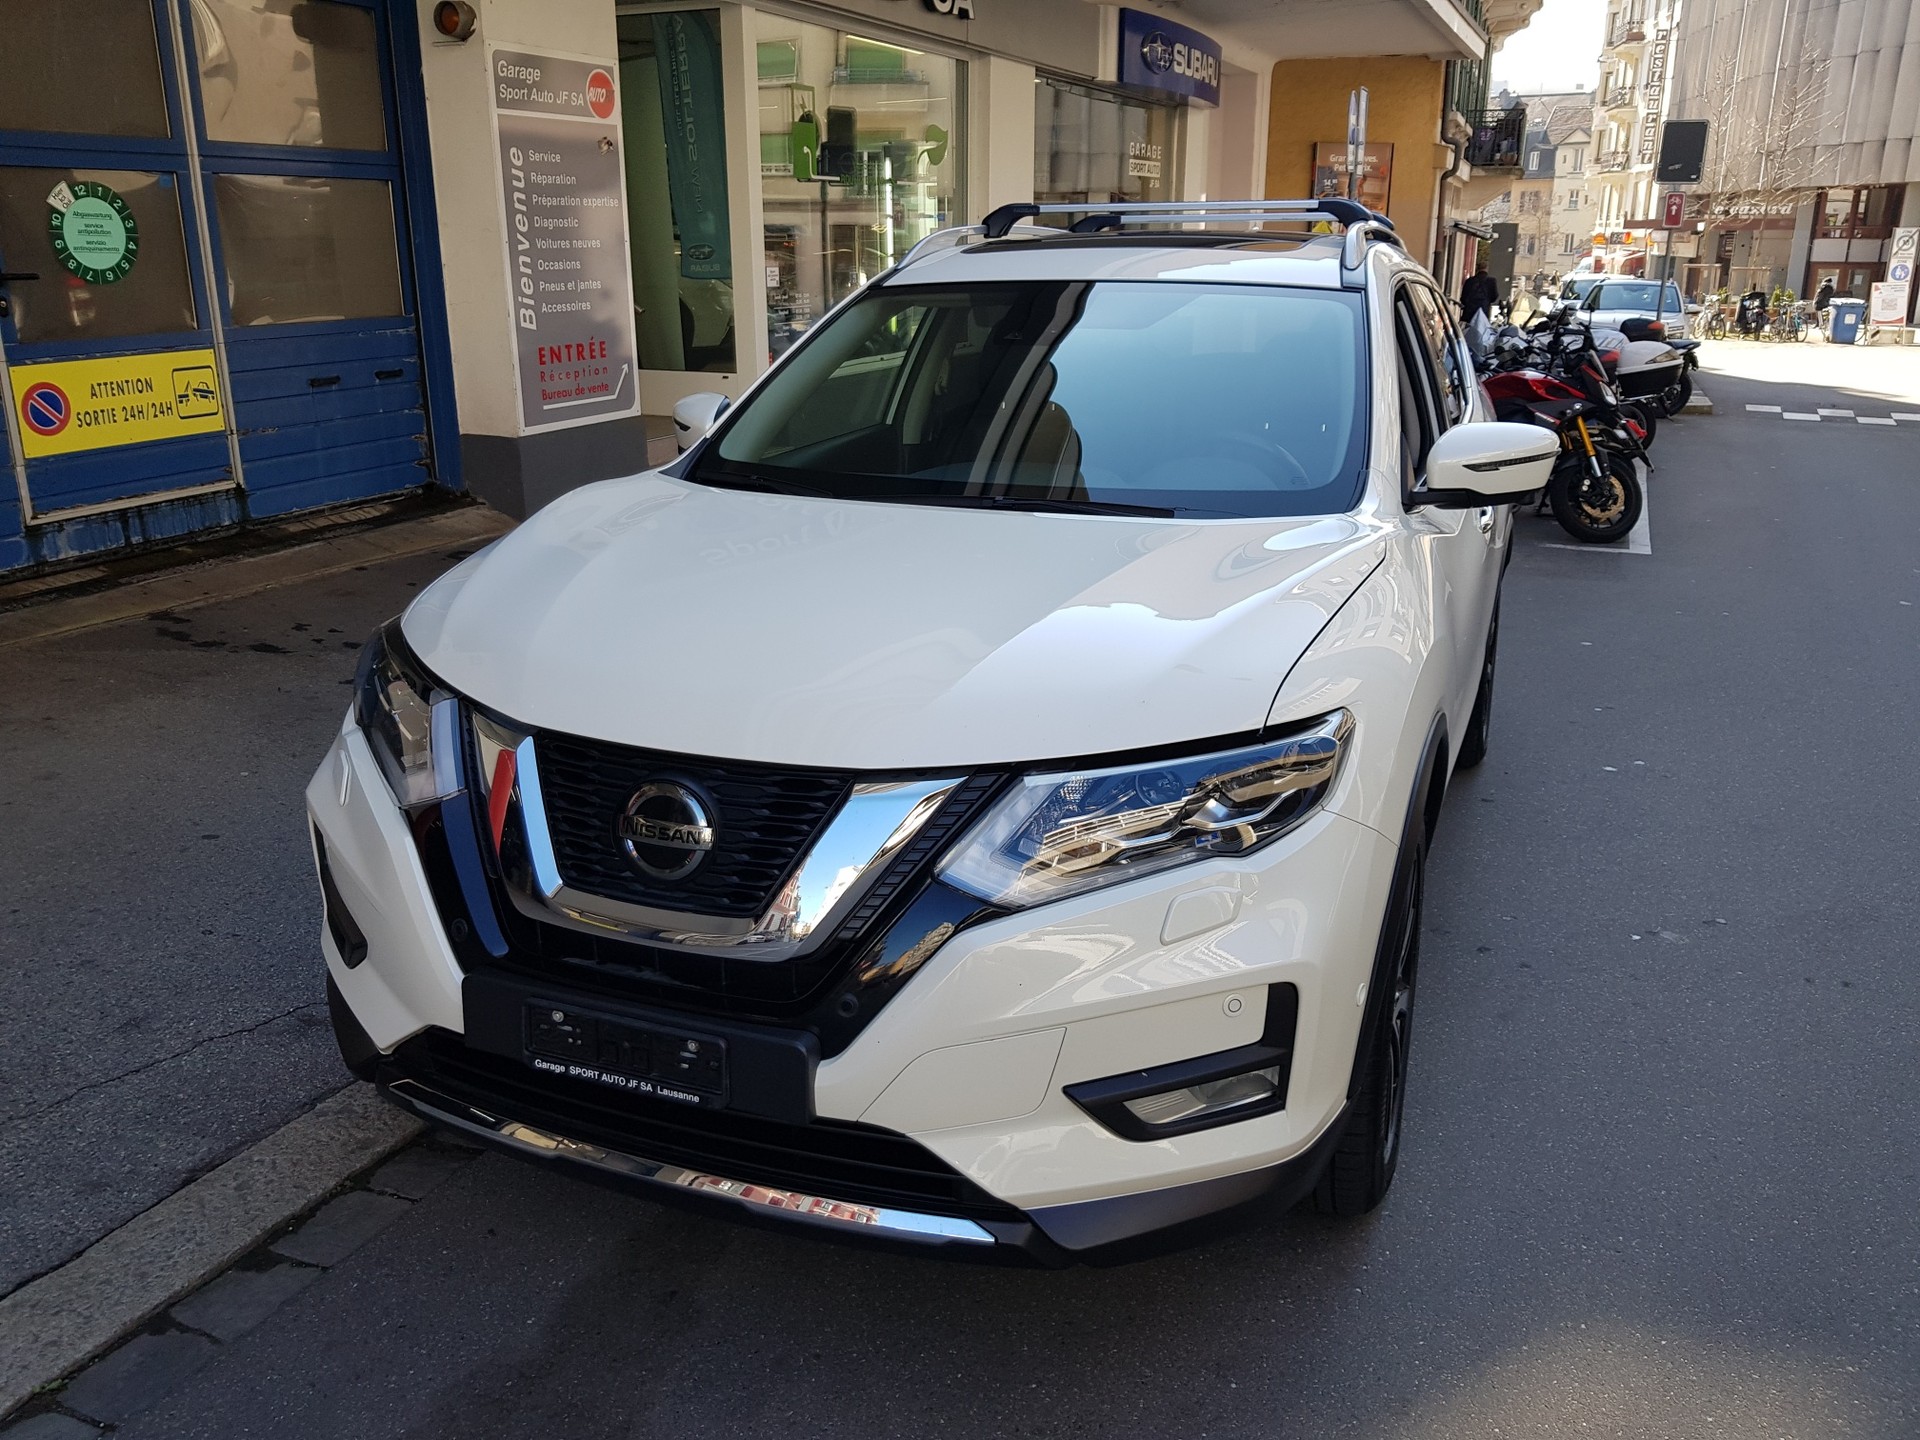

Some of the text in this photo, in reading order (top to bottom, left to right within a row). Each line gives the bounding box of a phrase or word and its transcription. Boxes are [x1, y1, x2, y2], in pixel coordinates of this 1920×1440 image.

[497, 60, 541, 84] Garage
[1173, 43, 1219, 88] SUBARU
[499, 84, 585, 106] Sport Auto JF SA
[1642, 29, 1668, 164] restaurant
[529, 150, 561, 163] Service
[1130, 142, 1162, 159] GARAGE
[531, 172, 577, 186] Réparation
[74, 185, 87, 196] 12
[98, 187, 102, 196] 1
[113, 199, 122, 209] 2
[532, 194, 619, 209] Préparation expertise
[52, 214, 62, 227] 10
[125, 220, 134, 228] 3
[534, 216, 579, 229] Diagnostic
[55, 240, 65, 249] 9
[128, 241, 137, 250] 4
[510, 147, 537, 331] Bienvenue
[536, 238, 601, 249] Voitures neuves
[68, 260, 77, 270] 8
[121, 260, 130, 270] 5
[538, 259, 581, 271] Occasions
[87, 271, 94, 281] 7
[106, 271, 114, 281] 6
[540, 280, 602, 293] Pneus et jantes
[541, 301, 591, 313] Accessoires
[538, 336, 607, 366] ENTRÉE
[540, 366, 608, 383] Réception
[90, 377, 154, 400] ATTENTION
[542, 382, 609, 401] Bureau de vente
[77, 400, 174, 428] SORTIE 24H/24H
[623, 816, 701, 845] NISSAN
[535, 1059, 700, 1103] Garage SPORT AUTO JF SA Lausanne
